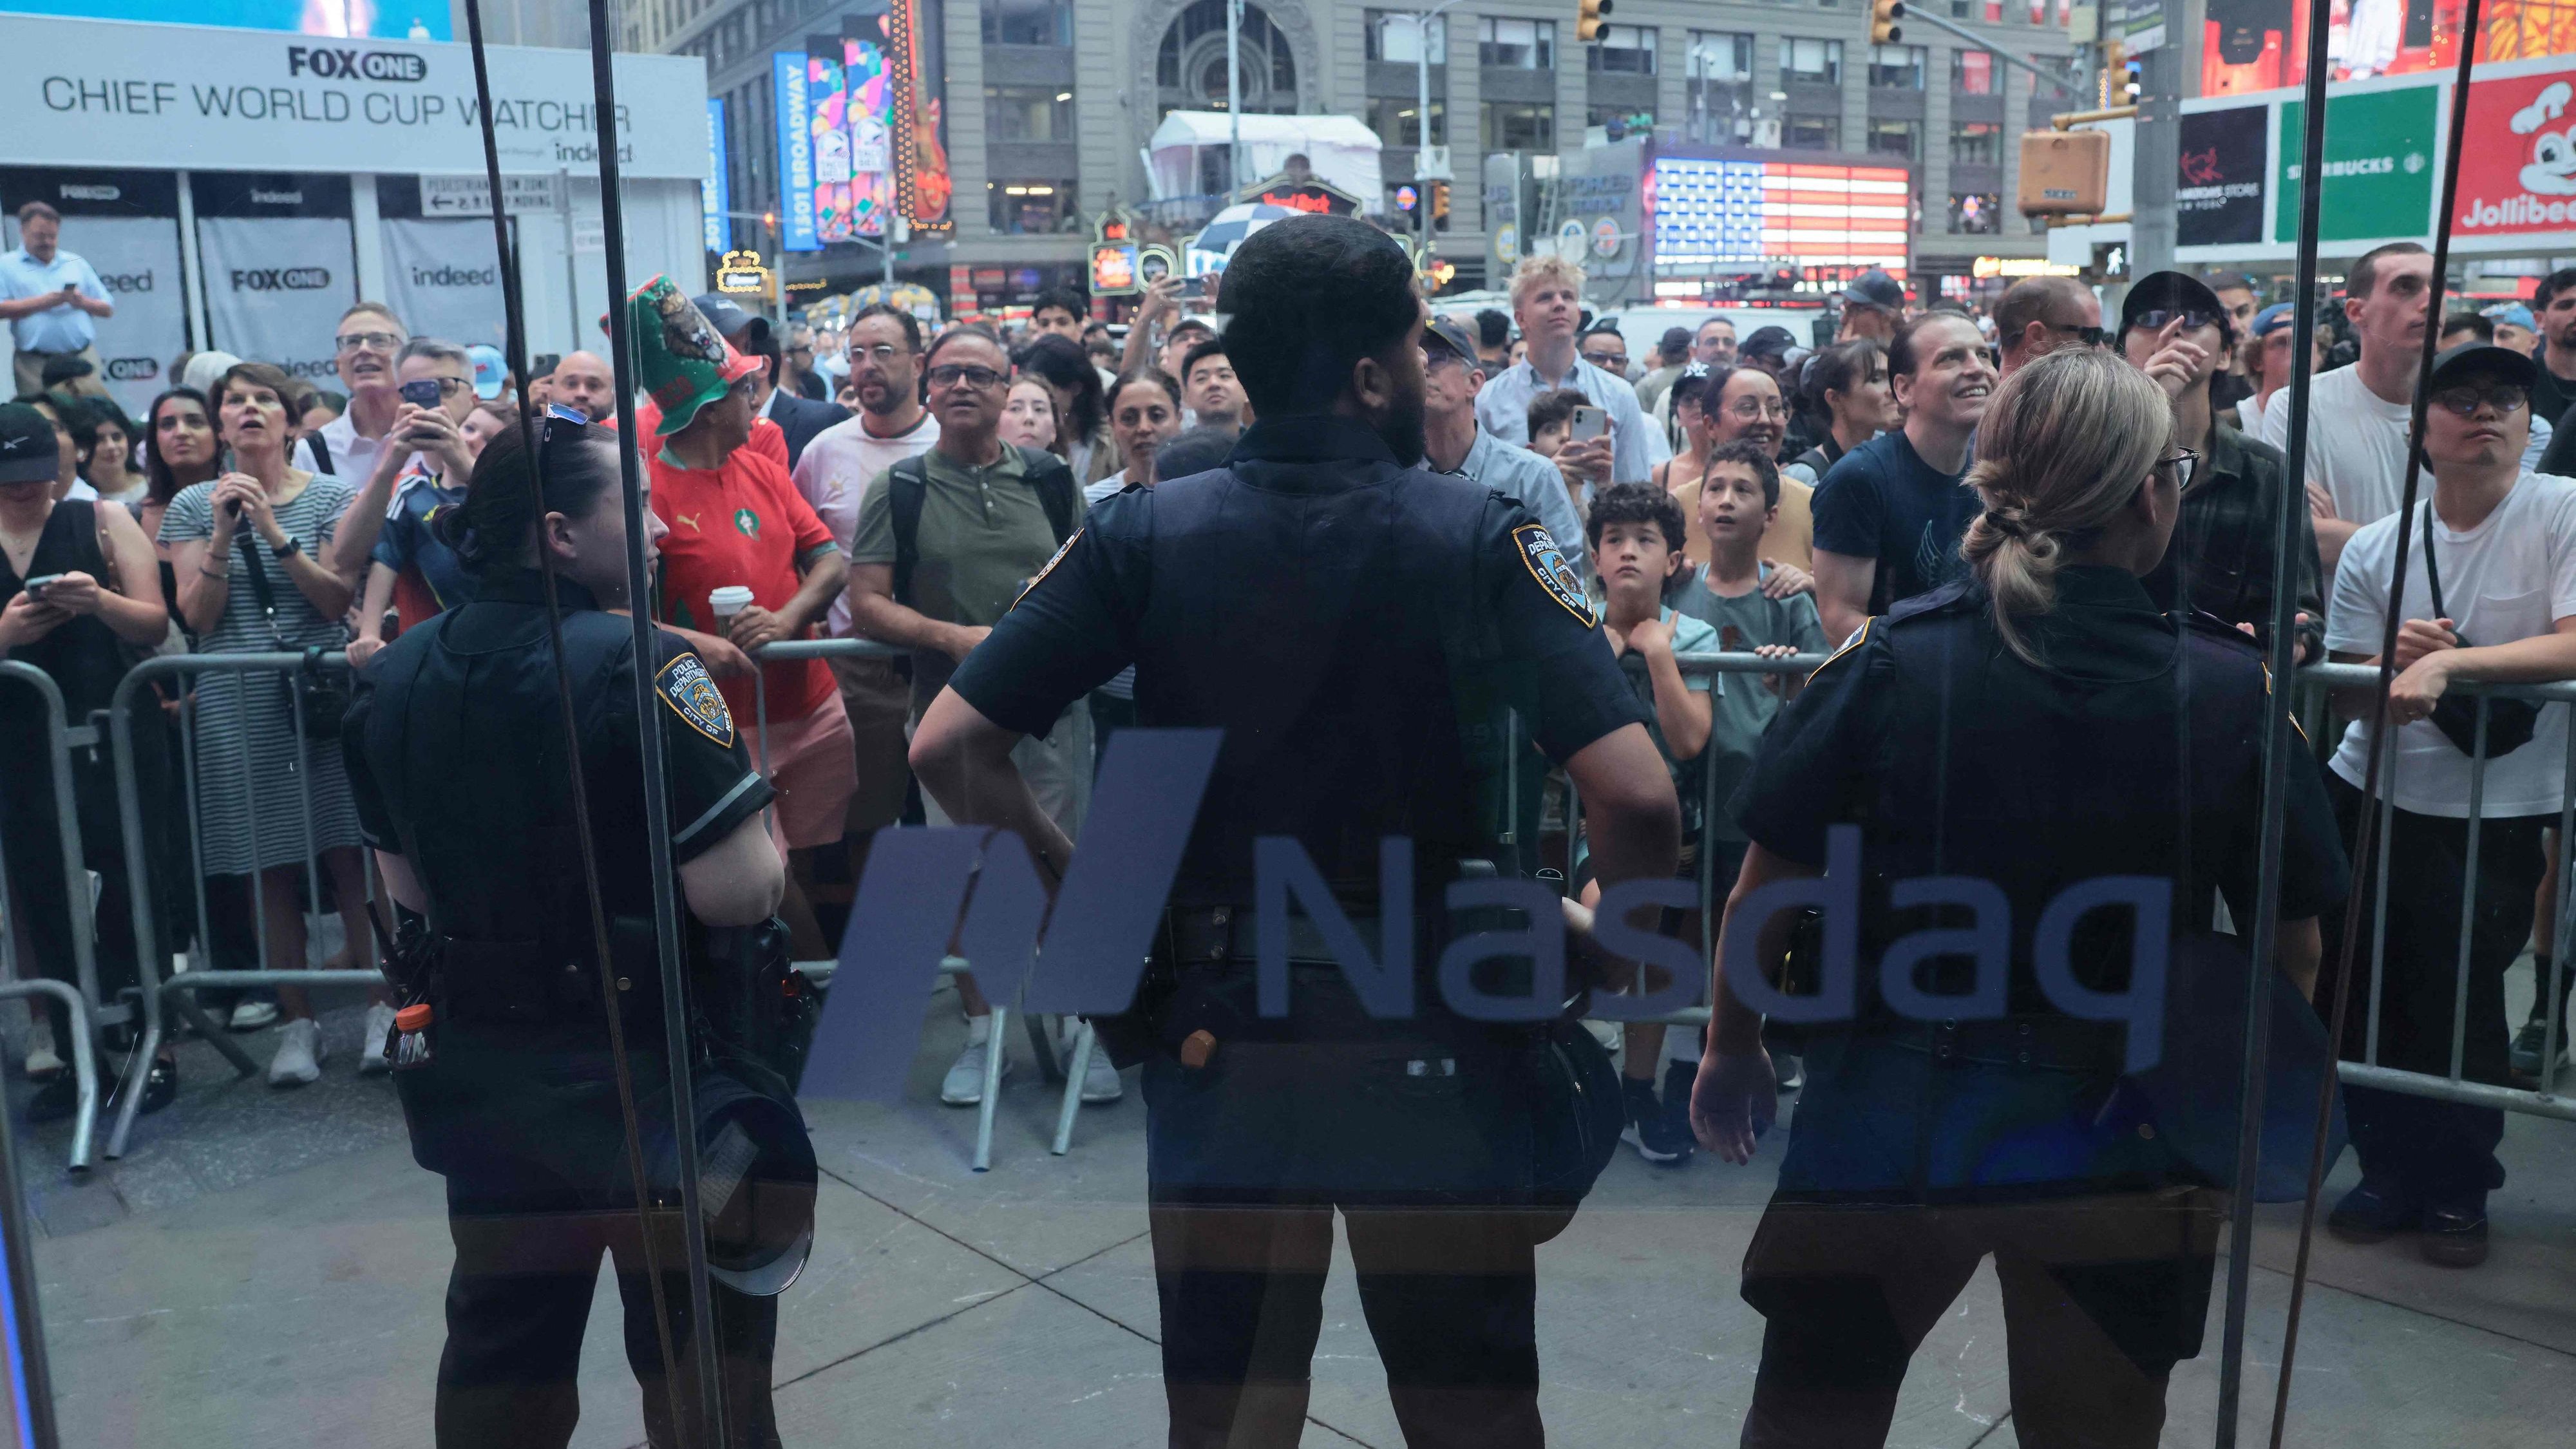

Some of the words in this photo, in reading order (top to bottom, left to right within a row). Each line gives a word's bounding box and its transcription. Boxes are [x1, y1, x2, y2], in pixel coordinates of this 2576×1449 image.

[43, 76, 176, 115] CHIEF
[192, 84, 350, 122] WORLD
[363, 92, 444, 126] CUP
[457, 96, 630, 133] WATCHR
[786, 64, 810, 188] BROADWAY
[556, 142, 632, 163] indd
[2287, 157, 2394, 180] SRBUCKS
[100, 269, 153, 292] eed
[412, 264, 495, 286] indeed
[1537, 567, 1561, 592] CITY
[1561, 593, 1577, 608] OF
[672, 659, 697, 679] POLICE
[683, 707, 705, 726] CITY
[706, 724, 718, 735] OF
[1255, 824, 2172, 1074] Nasdaq
